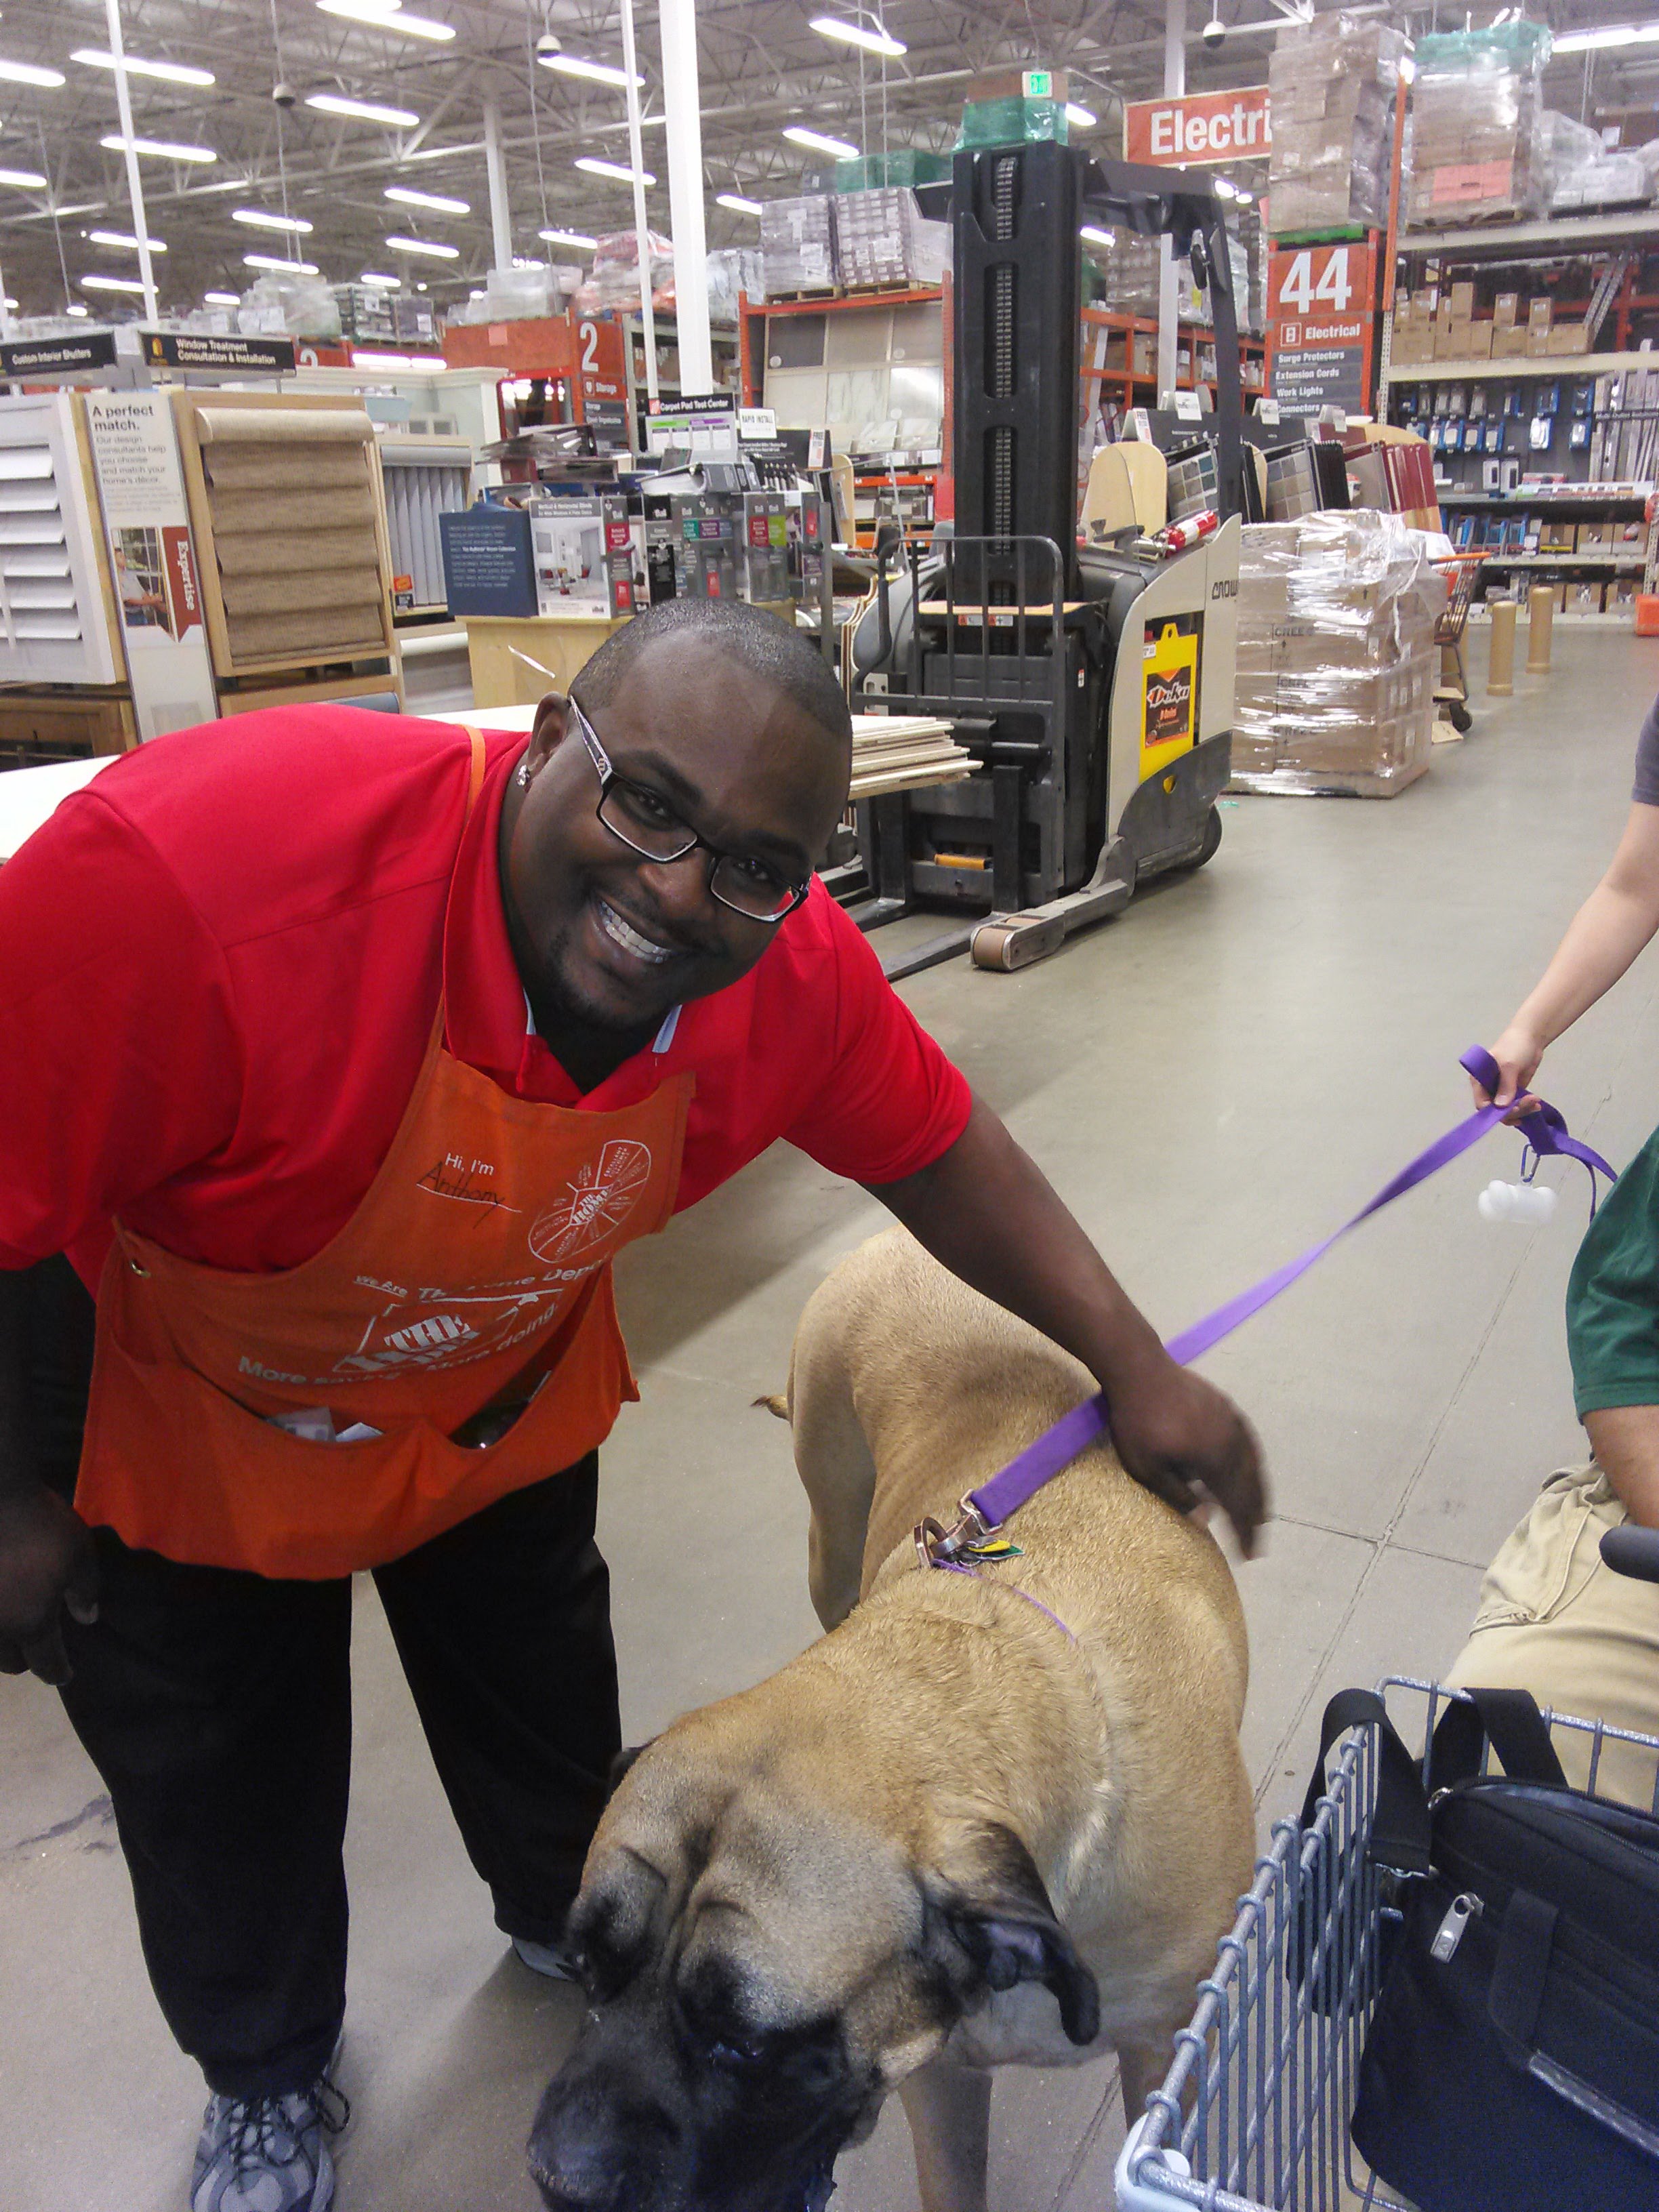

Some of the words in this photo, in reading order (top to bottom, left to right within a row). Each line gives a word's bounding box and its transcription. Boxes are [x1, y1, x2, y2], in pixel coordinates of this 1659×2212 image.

[1151, 98, 1272, 155] Electri
[1279, 248, 1352, 314] 44
[1305, 323, 1360, 340] Electrical
[176, 339, 208, 349] Window
[209, 341, 248, 352] Treatment
[579, 322, 599, 372] 2
[177, 350, 228, 363] Consultation
[235, 354, 276, 365] Installation
[1278, 354, 1301, 364] Surge
[1303, 351, 1345, 361] Protectors
[1275, 369, 1315, 380] Extension
[1316, 367, 1340, 379] Cords
[1277, 387, 1297, 397] Work
[1299, 386, 1324, 397] Lights
[92, 407, 102, 417] A
[106, 405, 155, 419] perfect
[660, 402, 680, 413] Carpet
[694, 399, 707, 409] Test
[708, 397, 729, 409] Center
[94, 419, 140, 432] match.
[177, 541, 194, 611] Expertise
[1212, 579, 1237, 600] CROW
[1147, 681, 1190, 709] Deka
[445, 1152, 465, 1172] Hi,
[470, 1159, 495, 1176] I'm
[416, 1161, 506, 1229] Anthony
[382, 1280, 408, 1296] Are
[384, 1315, 472, 1351] THE
[239, 1355, 306, 1384] More
